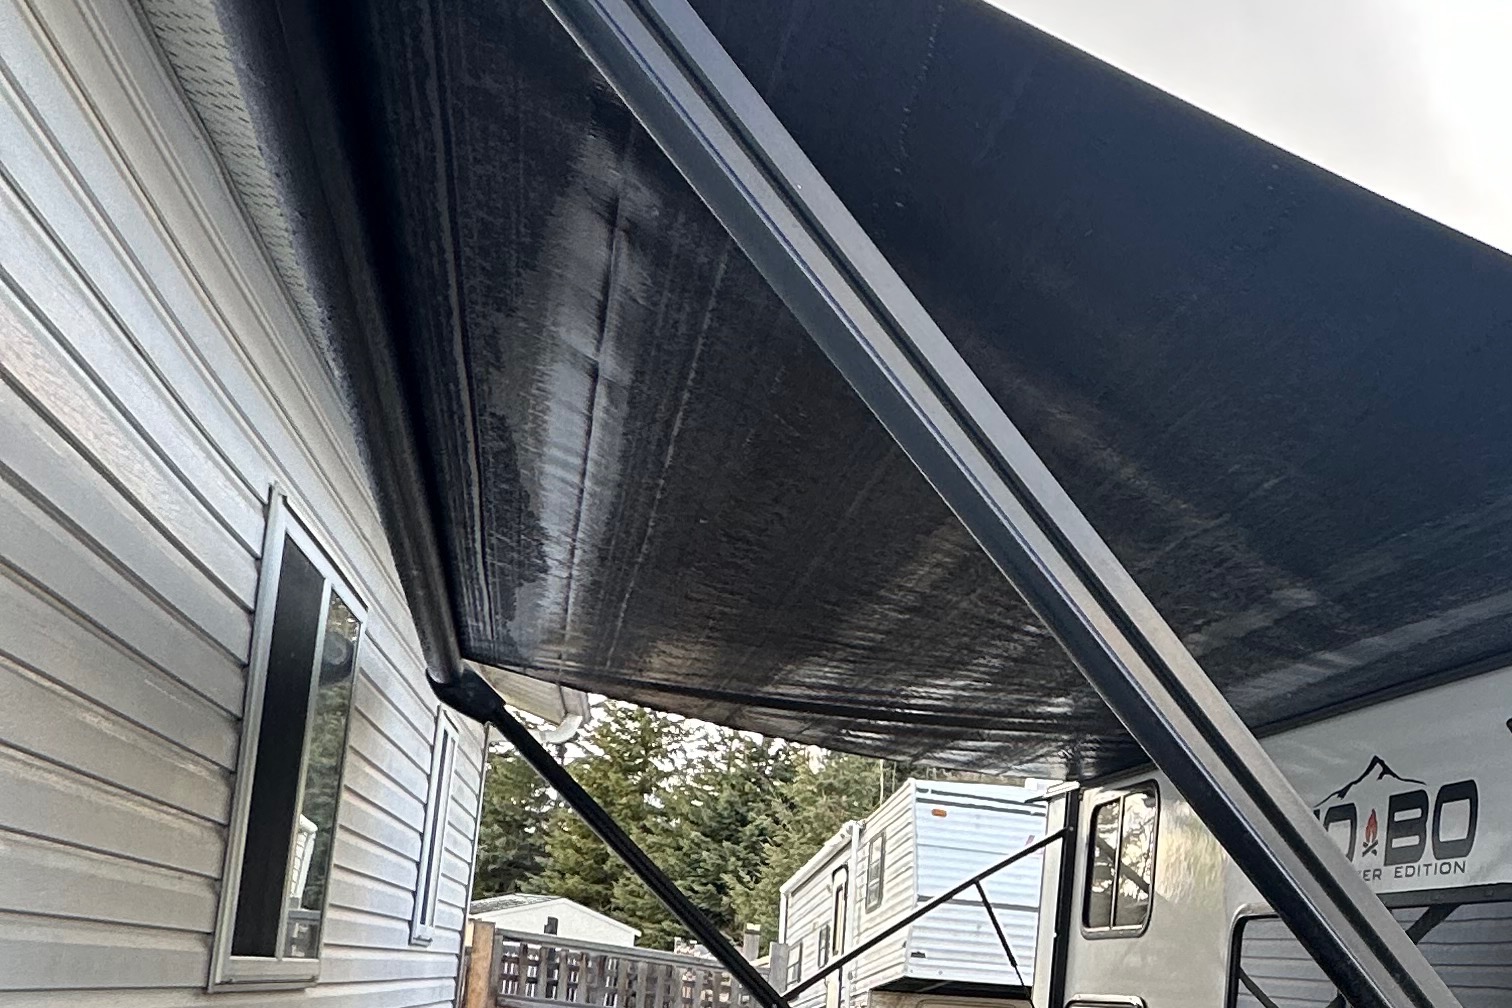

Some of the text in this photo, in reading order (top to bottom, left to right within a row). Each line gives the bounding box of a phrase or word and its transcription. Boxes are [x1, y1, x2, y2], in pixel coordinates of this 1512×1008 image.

[1313, 779, 1479, 866] OBO
[1359, 860, 1467, 882] ER EDITION
